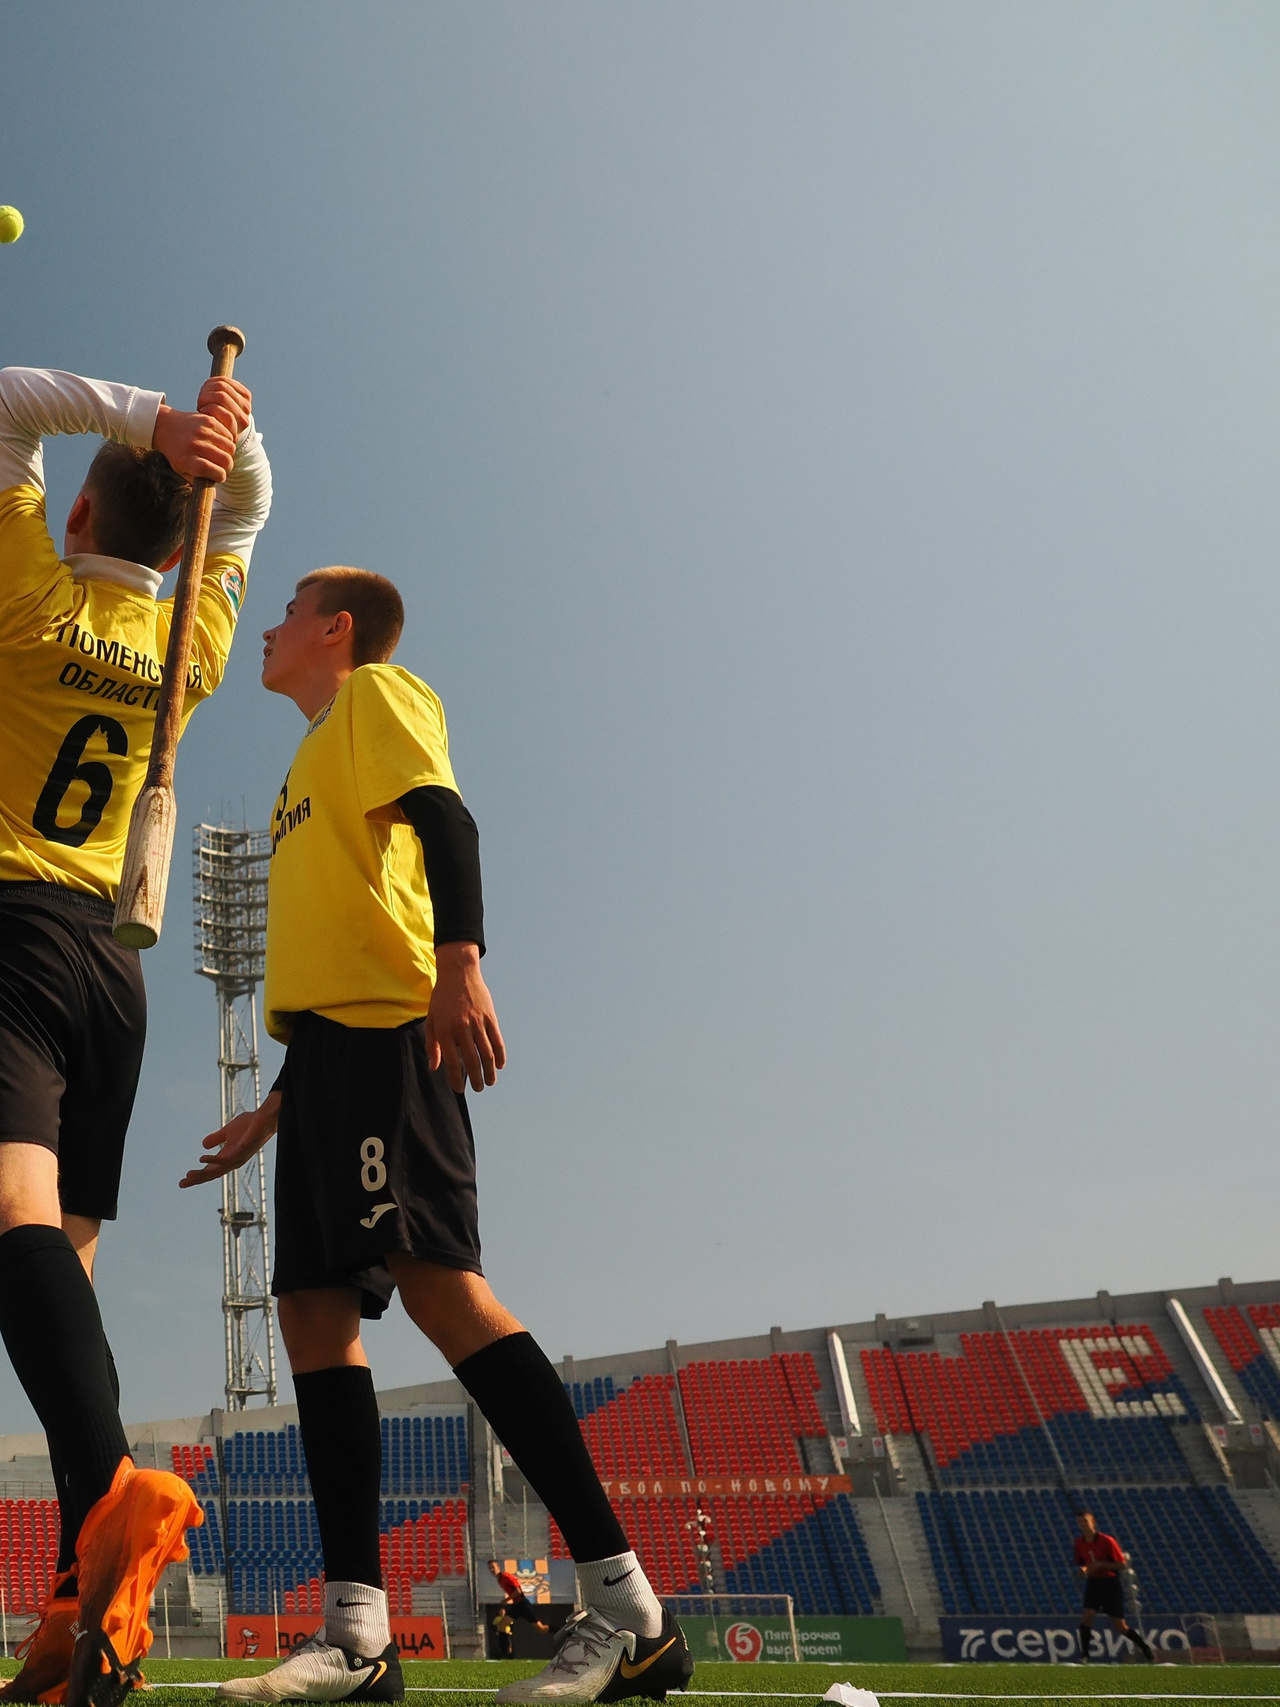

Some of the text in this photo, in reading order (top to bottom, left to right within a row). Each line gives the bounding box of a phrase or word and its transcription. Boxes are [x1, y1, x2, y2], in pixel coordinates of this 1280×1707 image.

[55, 622, 202, 689] ТЮМЕНСЯ
[32, 714, 129, 848] 6
[360, 1136, 387, 1192] 8
[735, 1626, 753, 1655] 5
